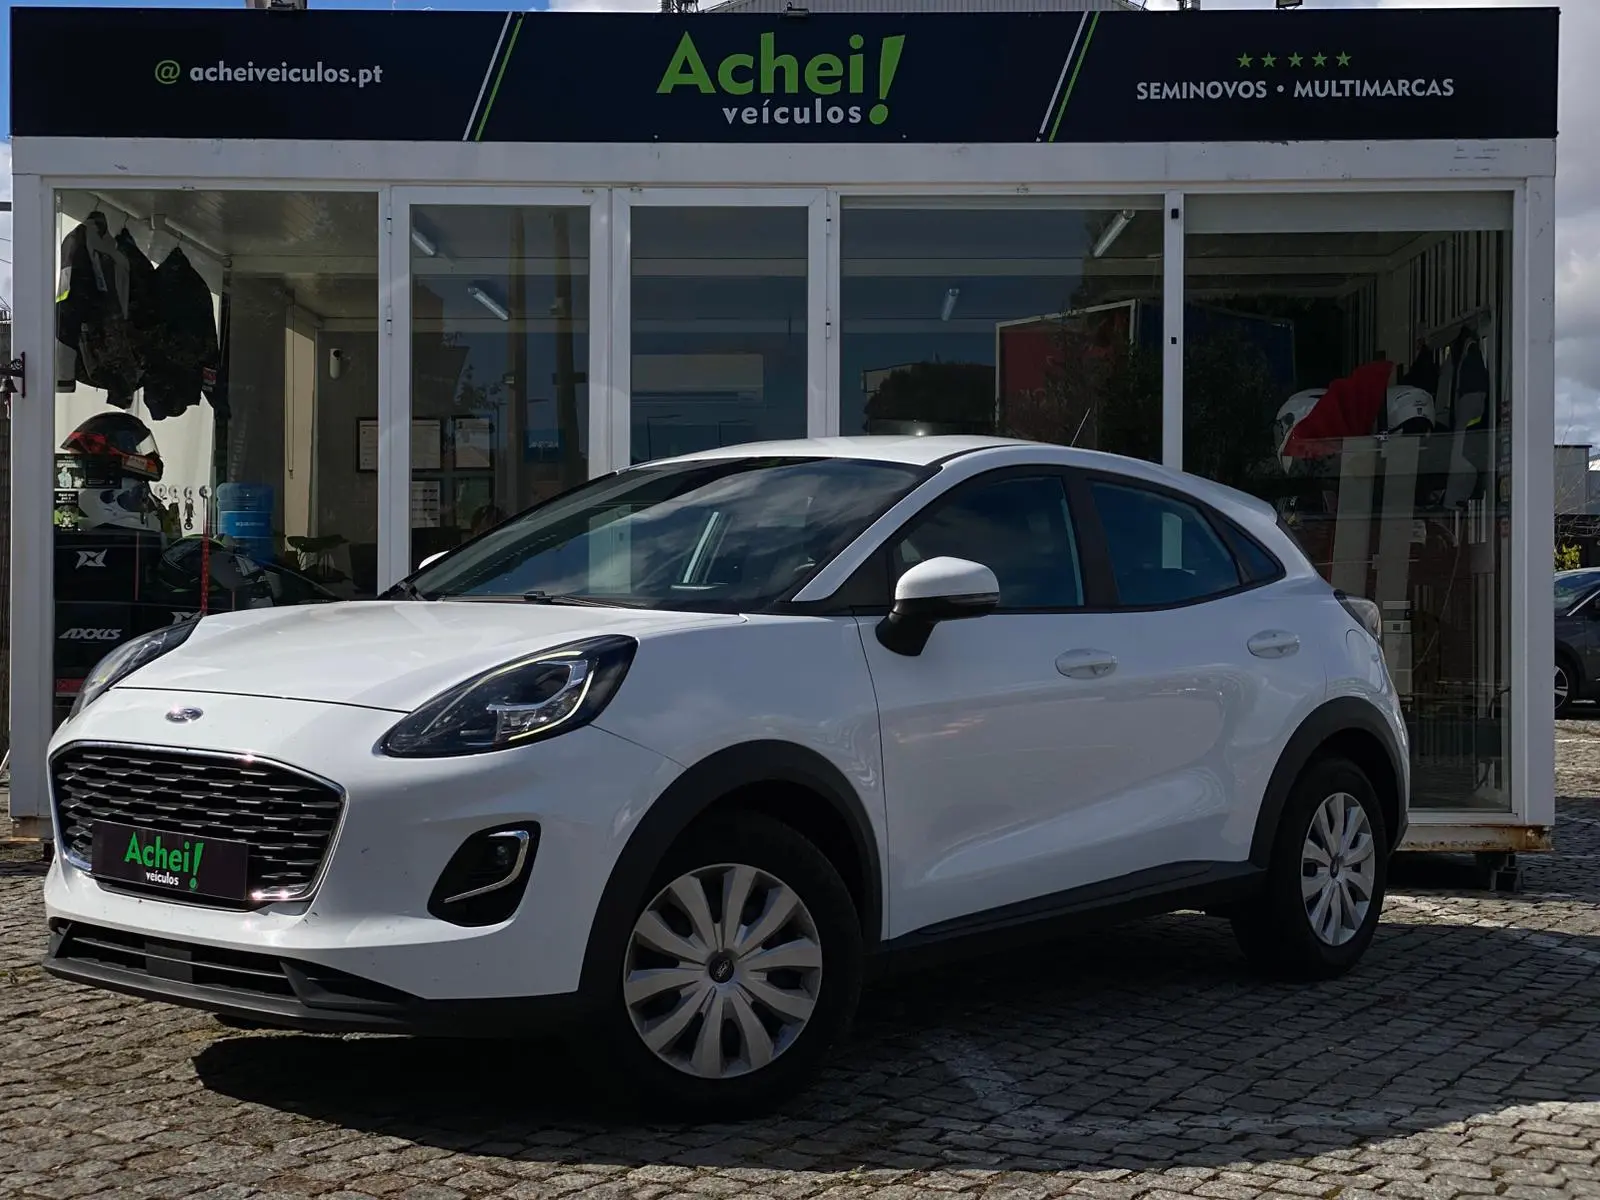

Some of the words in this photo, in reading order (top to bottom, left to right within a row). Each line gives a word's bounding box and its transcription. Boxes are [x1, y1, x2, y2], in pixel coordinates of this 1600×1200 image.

[154, 59, 181, 85] @
[189, 60, 384, 88] acheiveiculos.pt
[655, 30, 906, 126] Achei!
[1136, 80, 1267, 100] SEMINOVOS
[1293, 78, 1455, 98] MULTIMARCAS
[722, 98, 862, 125] veículos
[123, 831, 205, 890] Achei!
[145, 869, 180, 886] veículos
